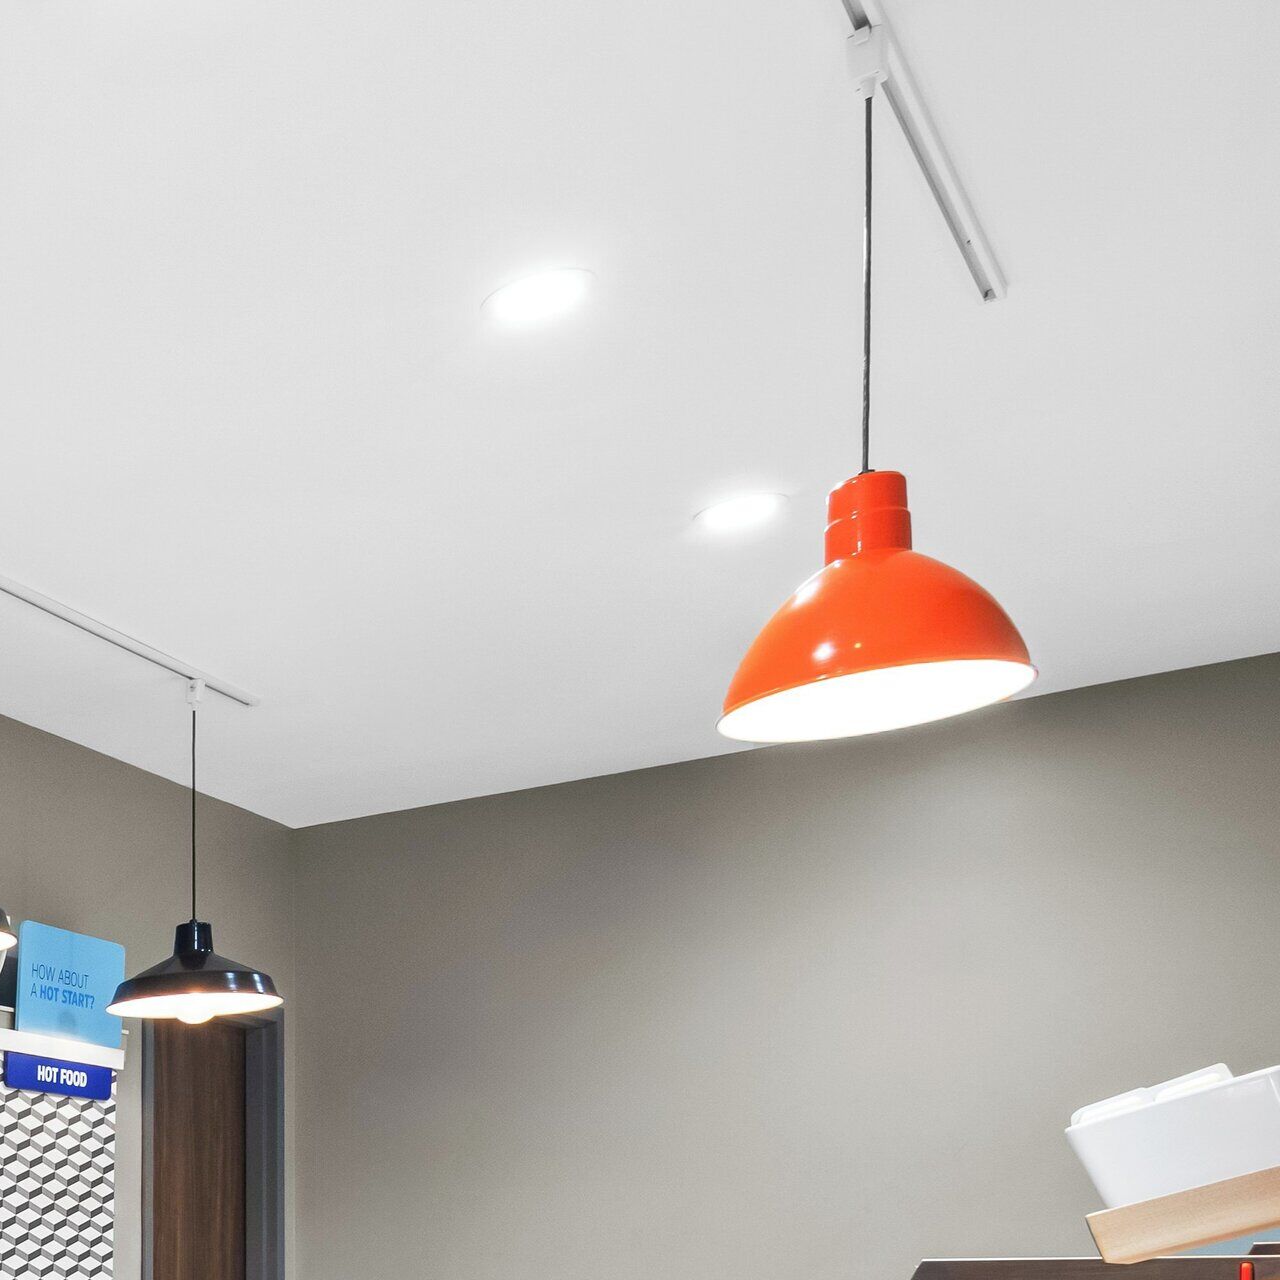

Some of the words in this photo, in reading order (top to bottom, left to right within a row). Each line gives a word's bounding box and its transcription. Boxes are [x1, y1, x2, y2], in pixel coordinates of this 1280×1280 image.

[32, 963, 55, 982] HOW
[57, 969, 89, 989] ABOUT
[30, 983, 38, 998] A
[40, 985, 60, 1001] HOT
[62, 989, 95, 1010] START?
[37, 1065, 59, 1084] HOT
[60, 1069, 87, 1087] FOOD
